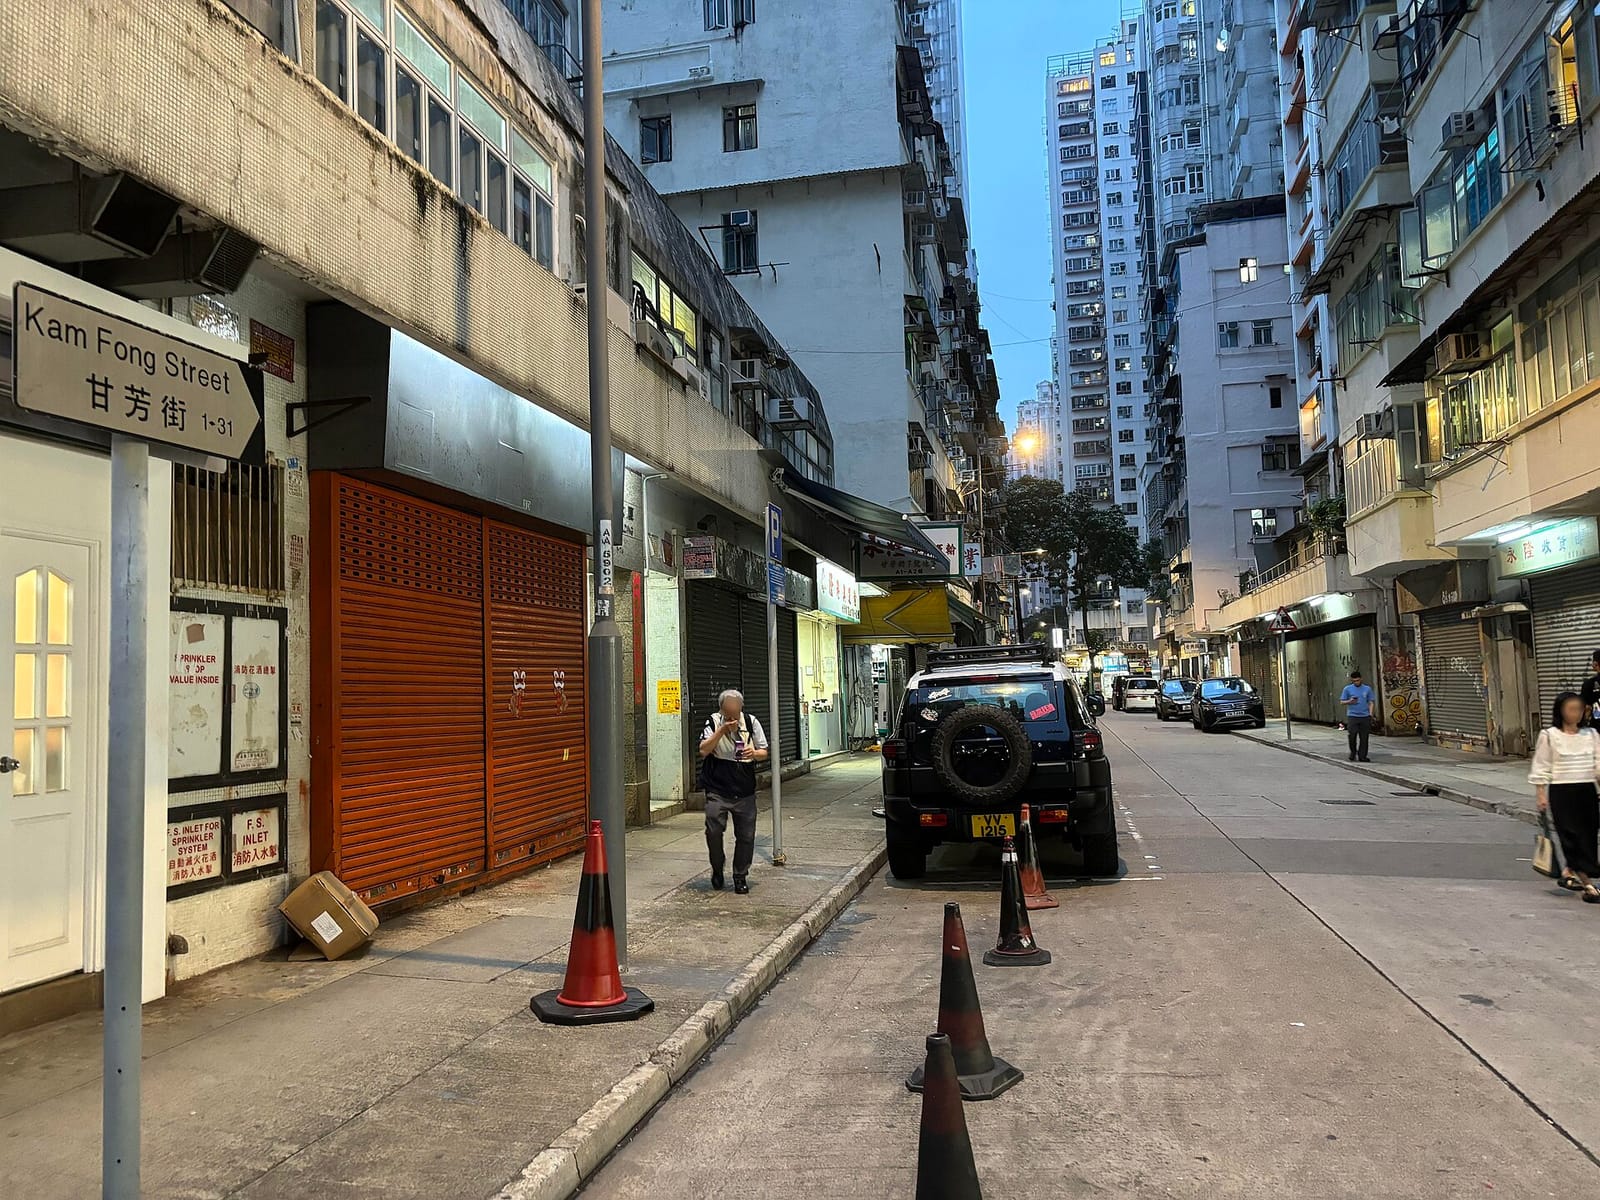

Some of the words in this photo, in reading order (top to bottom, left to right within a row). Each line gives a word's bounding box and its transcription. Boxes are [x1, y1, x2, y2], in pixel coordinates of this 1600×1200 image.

[25, 302, 87, 349] Kam
[97, 326, 156, 375] Fong
[165, 351, 230, 395] Street
[86, 372, 187, 432] 甘芳街
[201, 413, 234, 437] 1-31
[771, 510, 779, 554] P
[169, 675, 194, 684] VALUE
[195, 675, 220, 684] INSIDE
[983, 815, 1002, 826] VV
[182, 823, 204, 835] INLET
[205, 821, 220, 831] FOR
[980, 825, 1007, 837] 1215
[172, 832, 214, 846] SPRINKLER
[242, 831, 269, 846] INLET
[178, 843, 208, 856] SYSTEM
